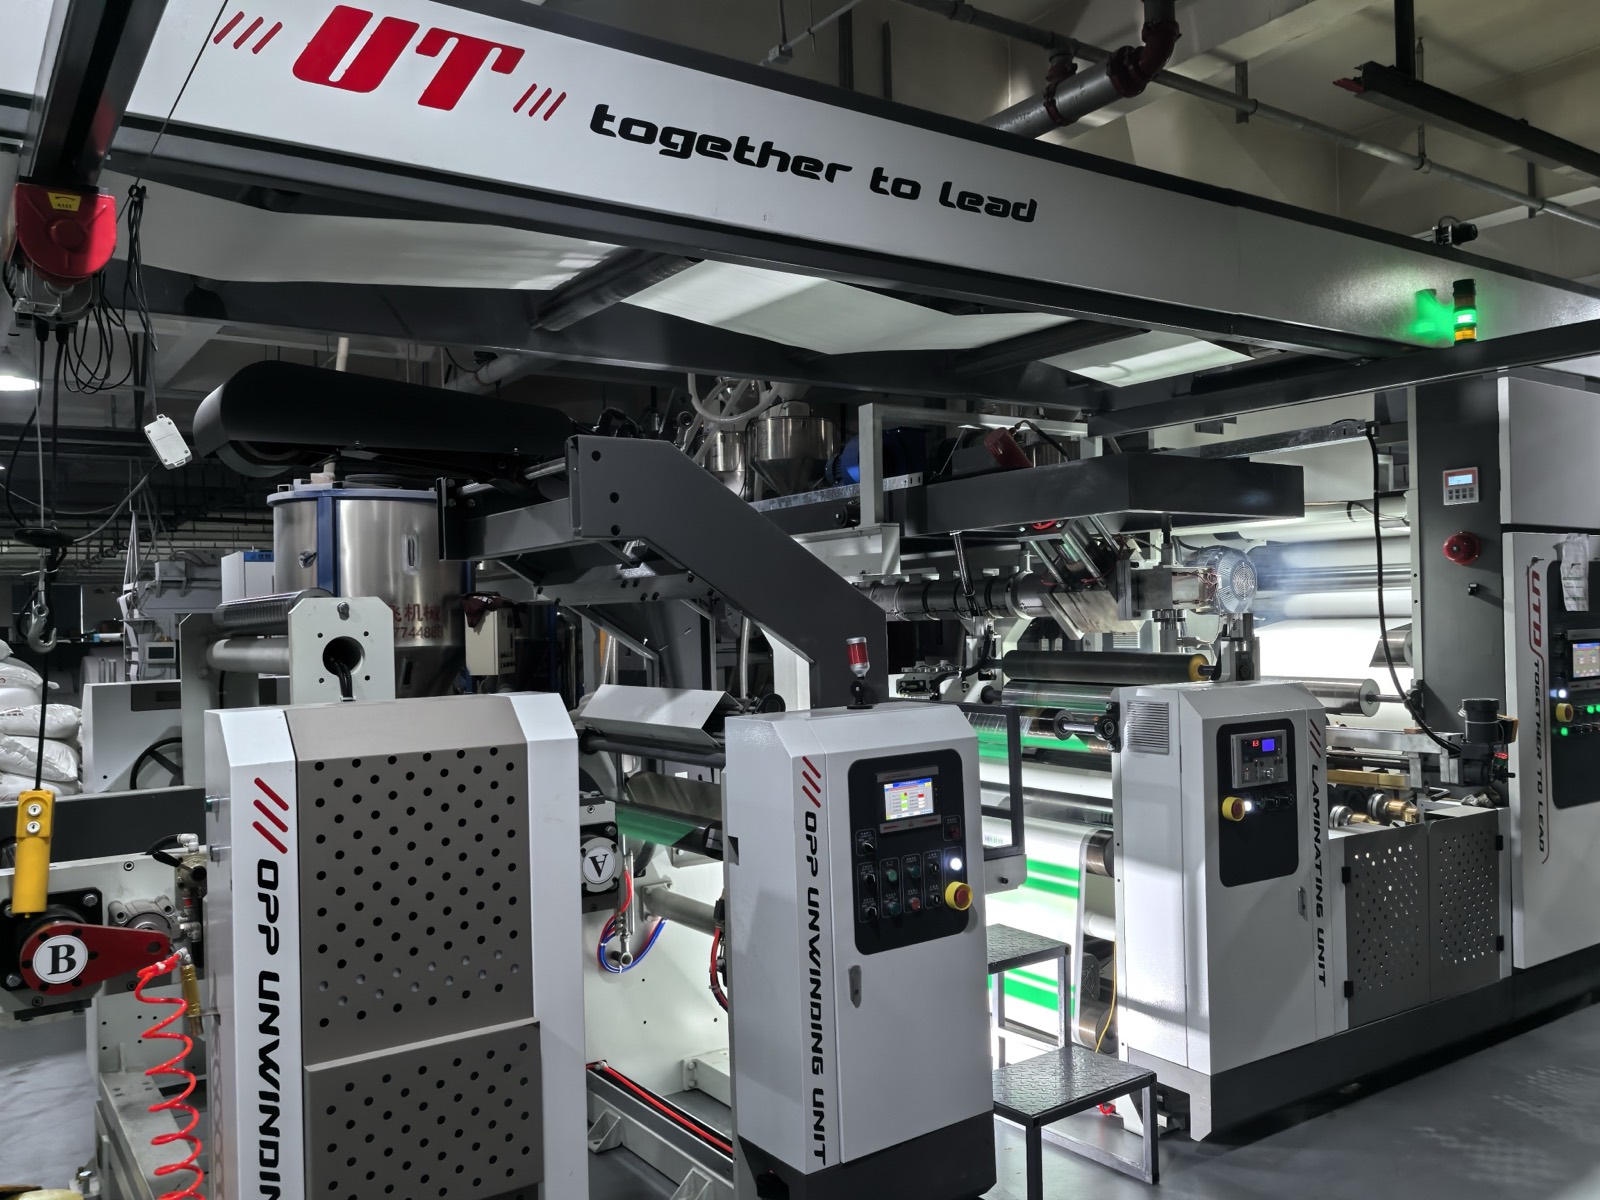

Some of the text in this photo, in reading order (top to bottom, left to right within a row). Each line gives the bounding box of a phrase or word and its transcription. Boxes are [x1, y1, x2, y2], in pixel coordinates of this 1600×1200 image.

[292, 4, 526, 112] UT
[589, 103, 1038, 223] together to lead
[1532, 659, 1545, 853] TOGETHER TO LEAD
[257, 858, 280, 956] OPP
[1311, 764, 1327, 988] LAMINATING UNIT
[47, 944, 77, 976] B
[804, 810, 826, 1167] OPP UNWINDING UNIT
